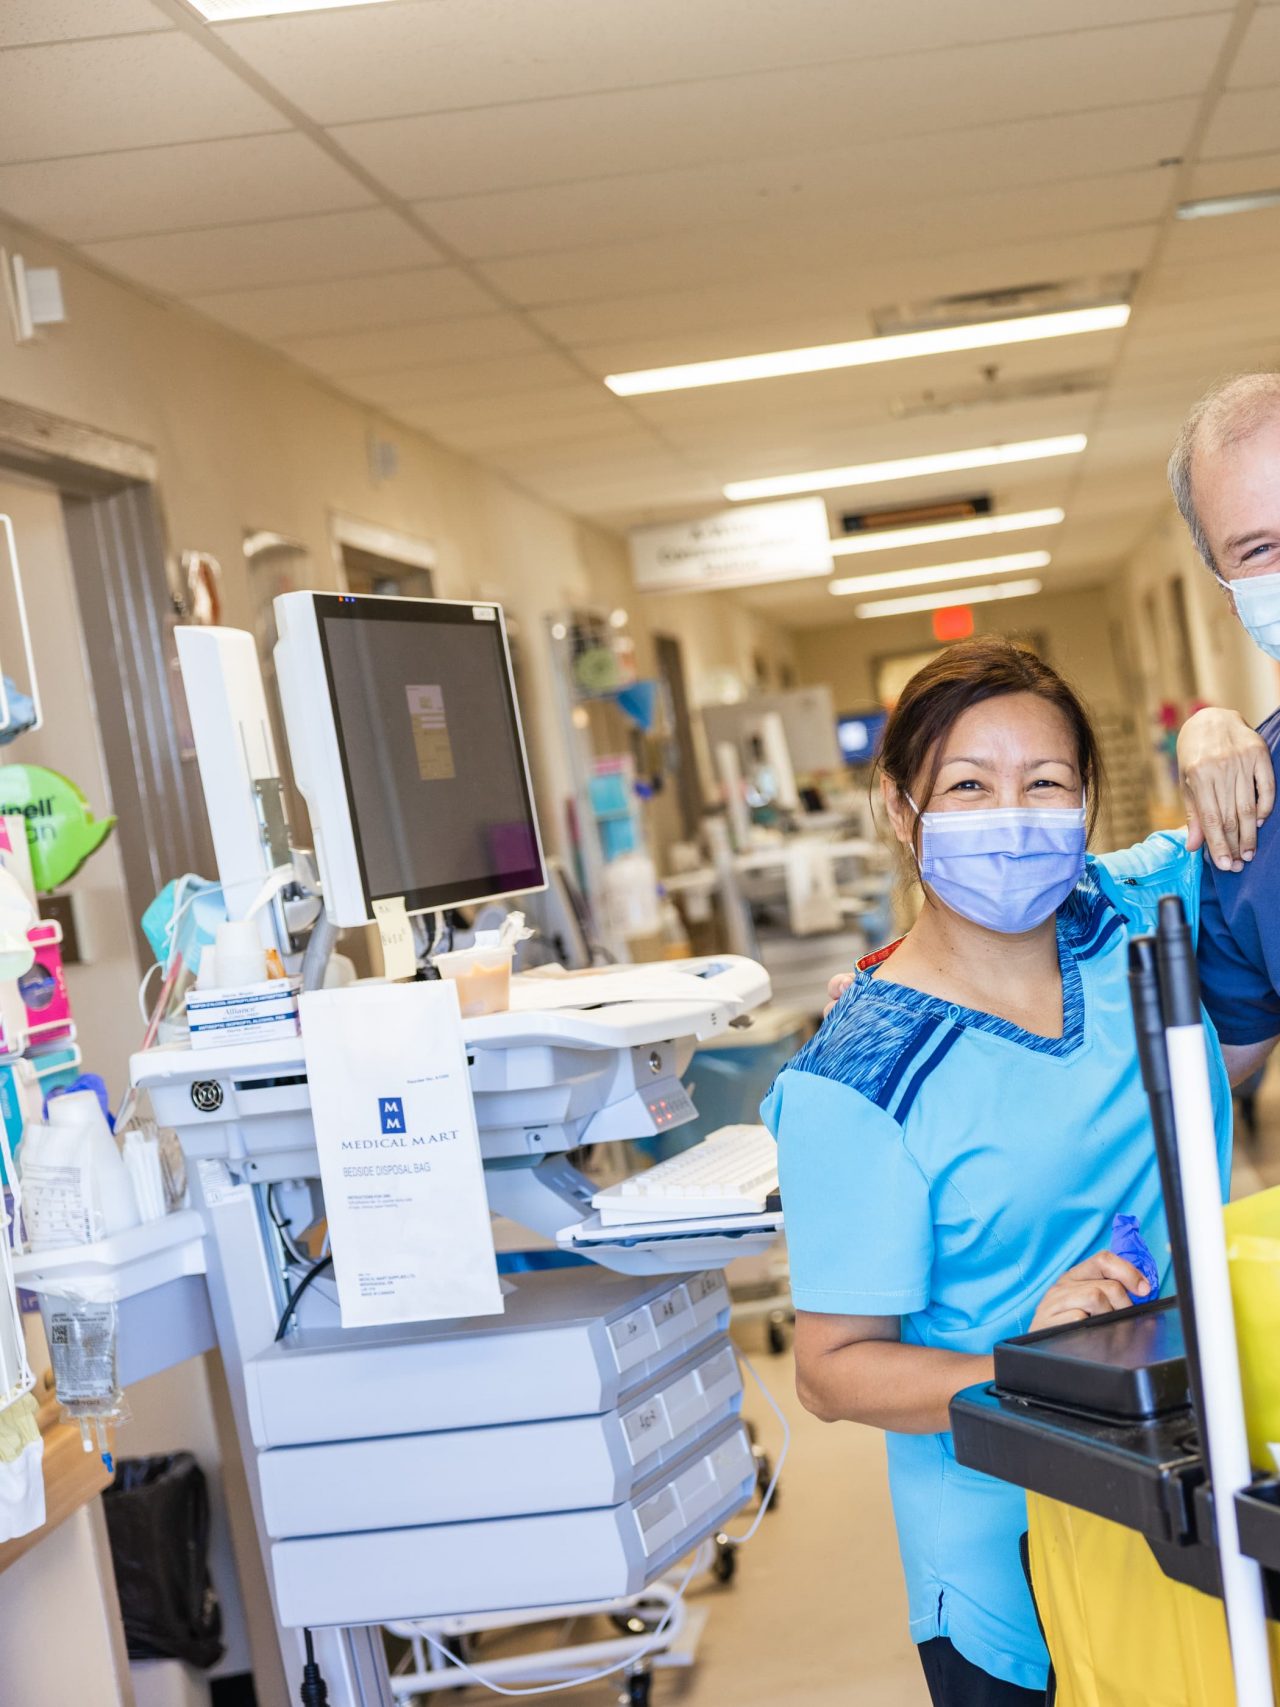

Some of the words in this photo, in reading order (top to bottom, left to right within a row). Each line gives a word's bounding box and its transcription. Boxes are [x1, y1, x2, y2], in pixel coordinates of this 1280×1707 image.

[225, 1006, 257, 1016] Alliance
[384, 1101, 400, 1113] M
[386, 1118, 402, 1129] M
[341, 1137, 408, 1150] MEDICAL
[411, 1130, 459, 1146] MART
[343, 1166, 375, 1178] BEDSIDE
[375, 1163, 414, 1176] DISPOSAL
[413, 1162, 432, 1173] BAG
